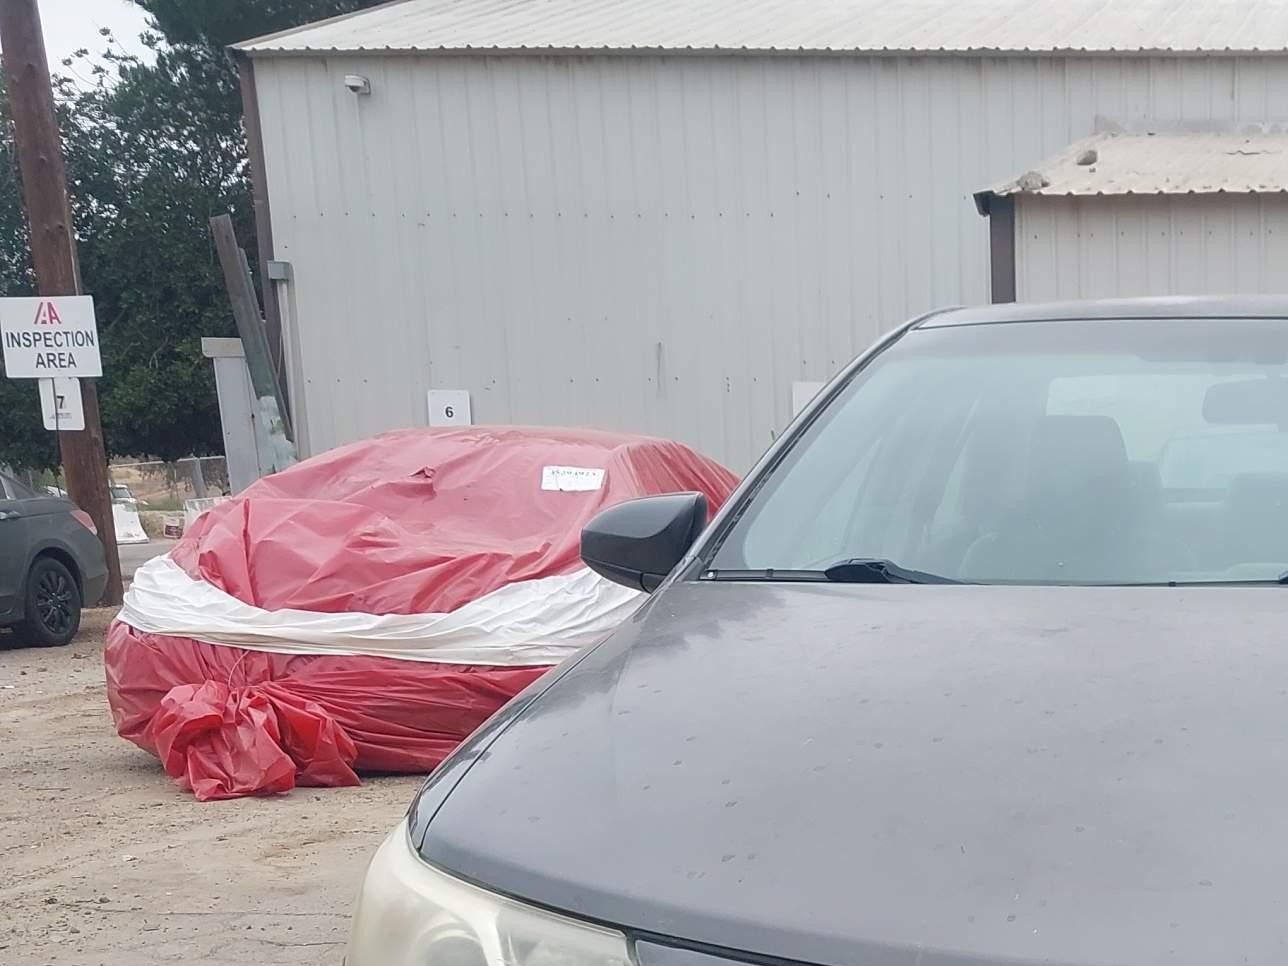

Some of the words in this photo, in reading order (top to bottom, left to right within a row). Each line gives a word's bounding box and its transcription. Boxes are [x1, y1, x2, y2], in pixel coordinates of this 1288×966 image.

[5, 330, 95, 348] INSPECTION
[35, 352, 77, 369] AREA
[56, 395, 65, 409] 7
[445, 406, 454, 418] 6
